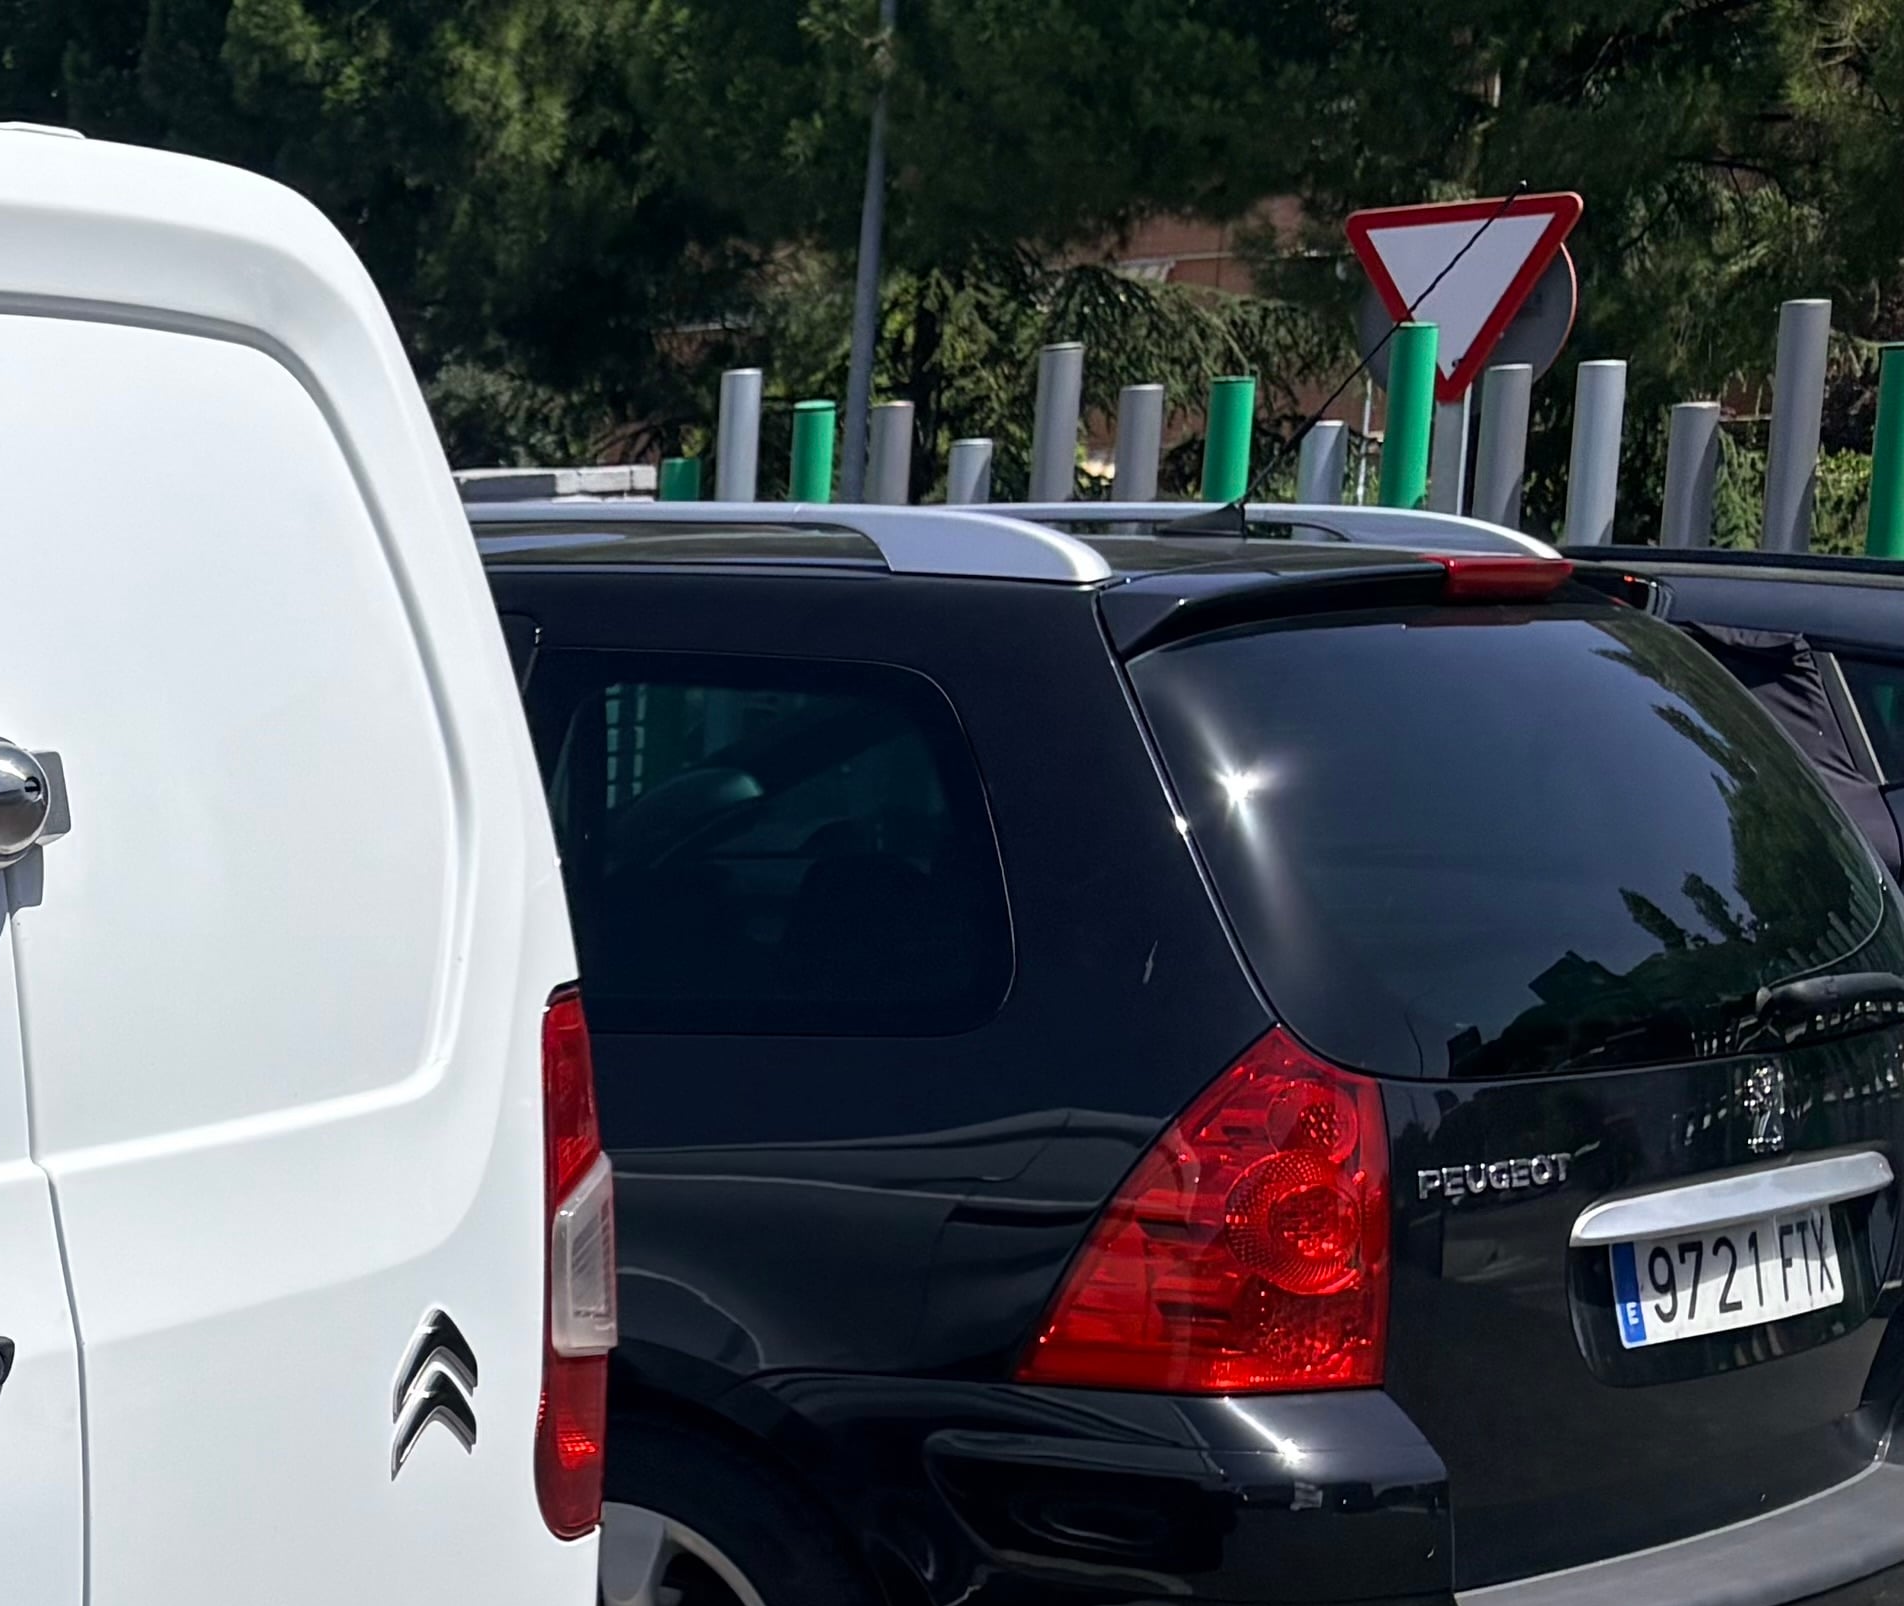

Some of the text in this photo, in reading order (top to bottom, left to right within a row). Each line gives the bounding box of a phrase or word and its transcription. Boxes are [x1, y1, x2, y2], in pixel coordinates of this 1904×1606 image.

[1417, 1152, 1572, 1199] PEUGEOT
[1648, 1214, 1835, 1323] 9721 FTX
[1626, 1302, 1640, 1326] E
